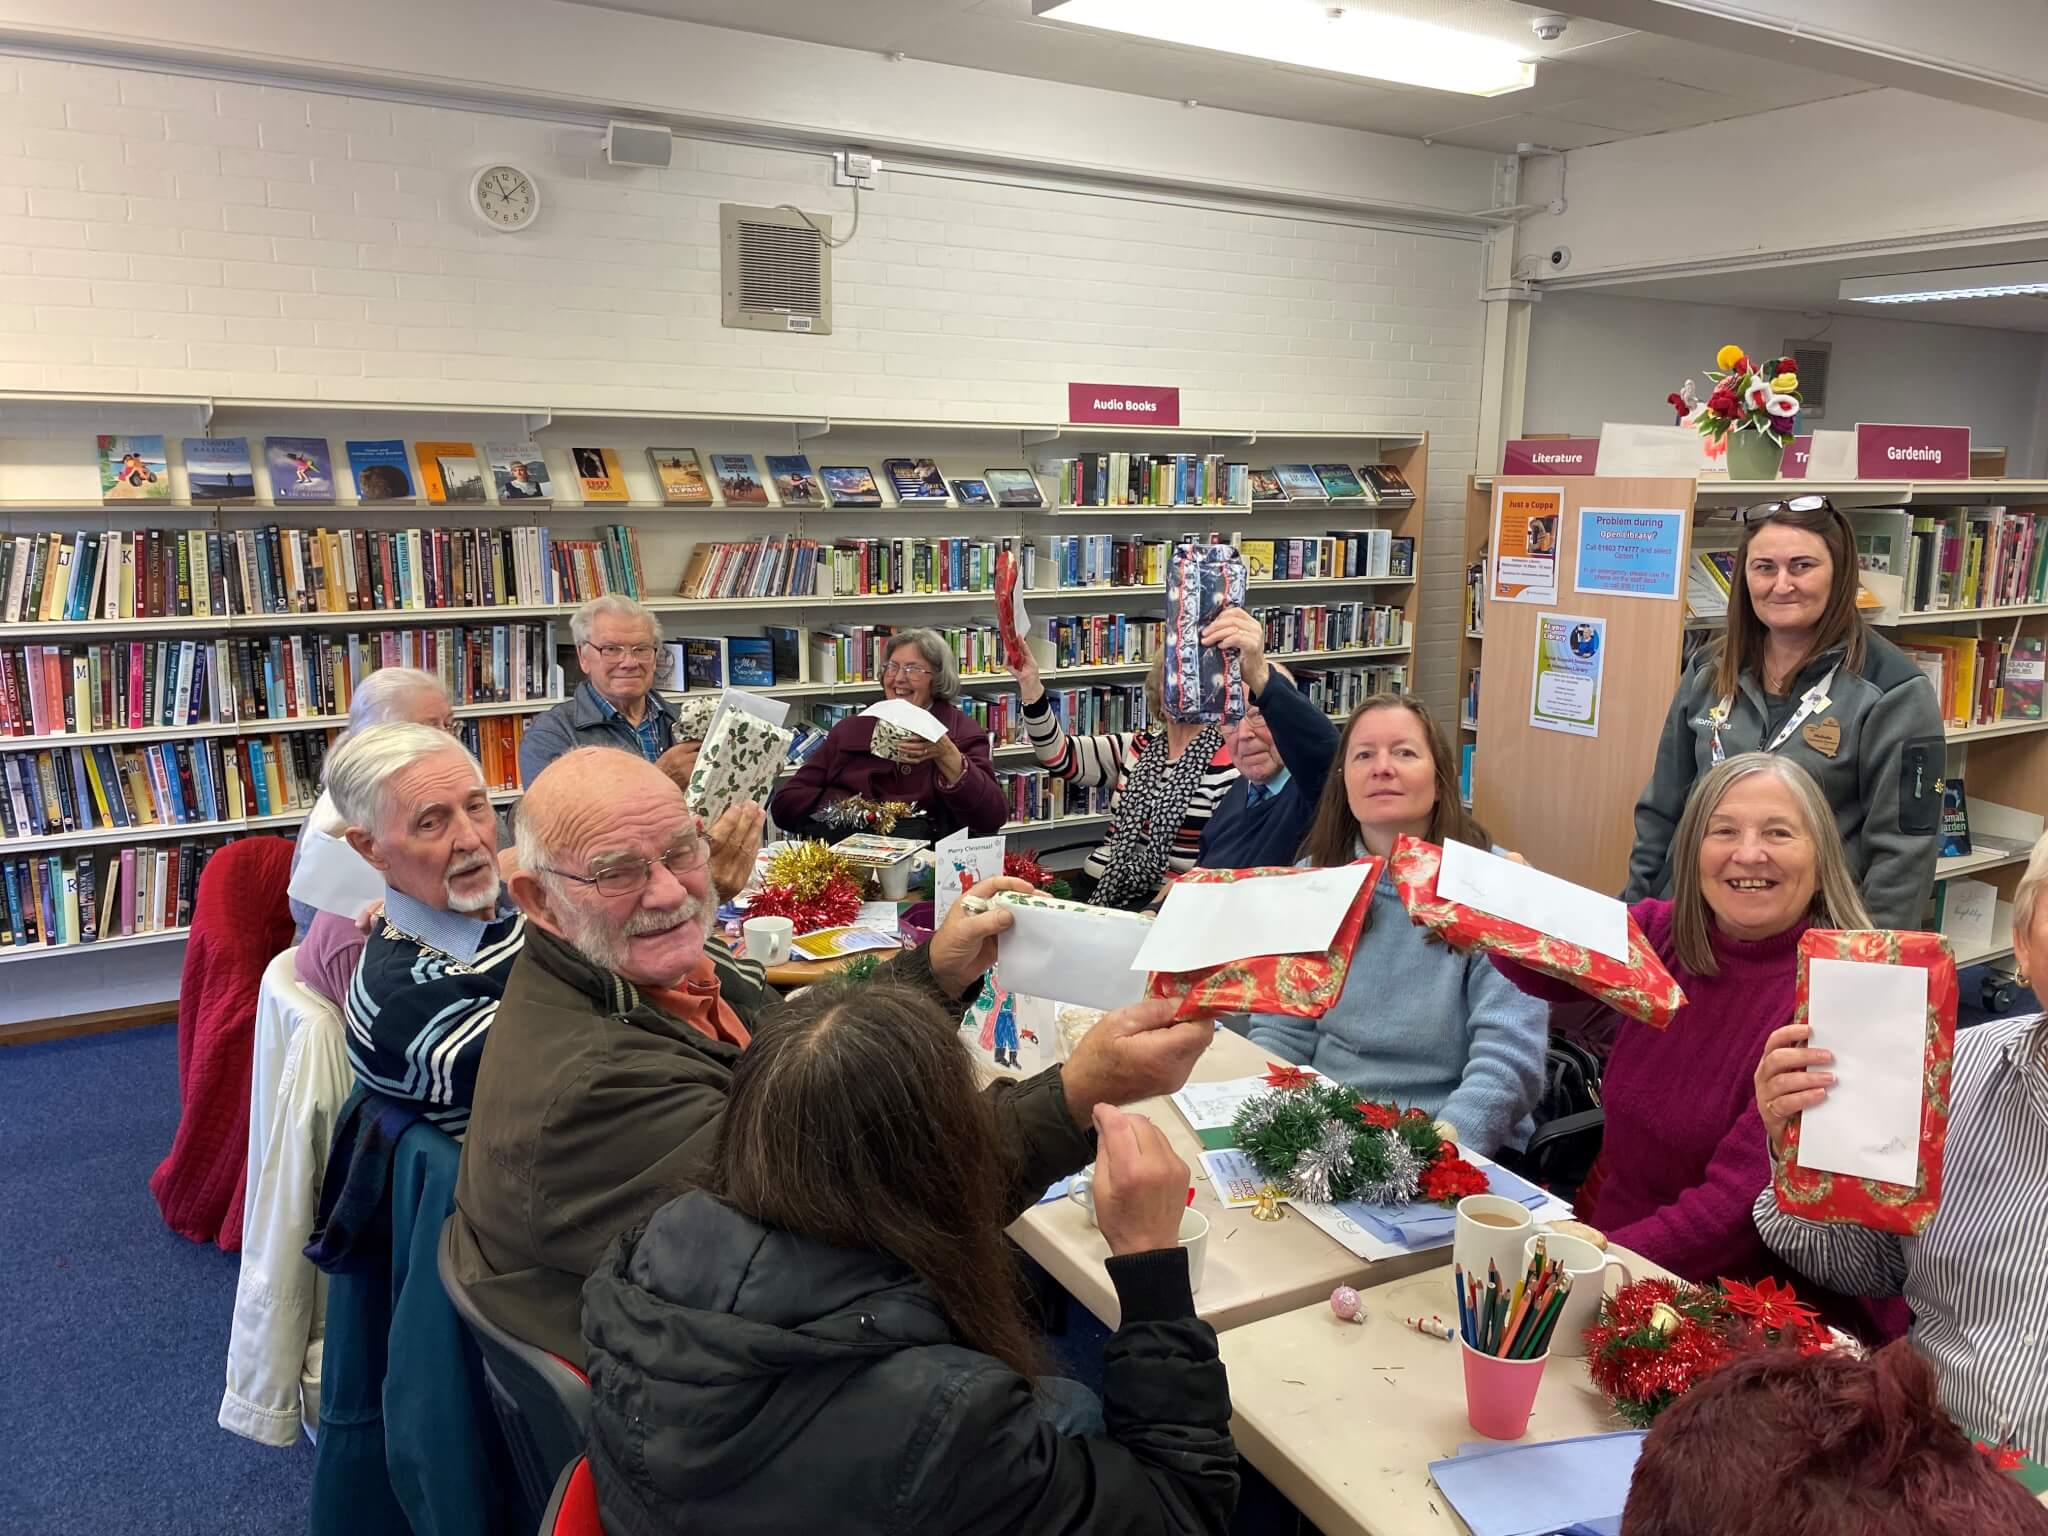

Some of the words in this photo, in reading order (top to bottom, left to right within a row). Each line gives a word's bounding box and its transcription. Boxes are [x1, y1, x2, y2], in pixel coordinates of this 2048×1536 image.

[501, 173, 510, 181] 12
[1093, 397, 1123, 412] Audio
[1125, 398, 1157, 413] Books
[1532, 452, 1583, 464] Literature
[1887, 446, 1942, 463] Gardening
[1508, 501, 1524, 509] Just
[1531, 501, 1553, 511] Cuppa
[1596, 515, 1632, 526] Problem
[1634, 517, 1663, 529] during
[1600, 530, 1621, 539] Open
[1623, 530, 1658, 541] Library?
[1585, 543, 1597, 551] Call
[1640, 546, 1653, 554] and
[122, 550, 132, 564] K
[178, 541, 187, 582] DANGEROUS
[400, 542, 409, 573] RUTHLESS
[76, 665, 87, 679] M
[7, 678, 17, 702] BLOOD
[126, 760, 140, 774] NO
[1943, 811, 1965, 823] small
[1942, 821, 1967, 832] arden
[948, 847, 964, 855] Merry
